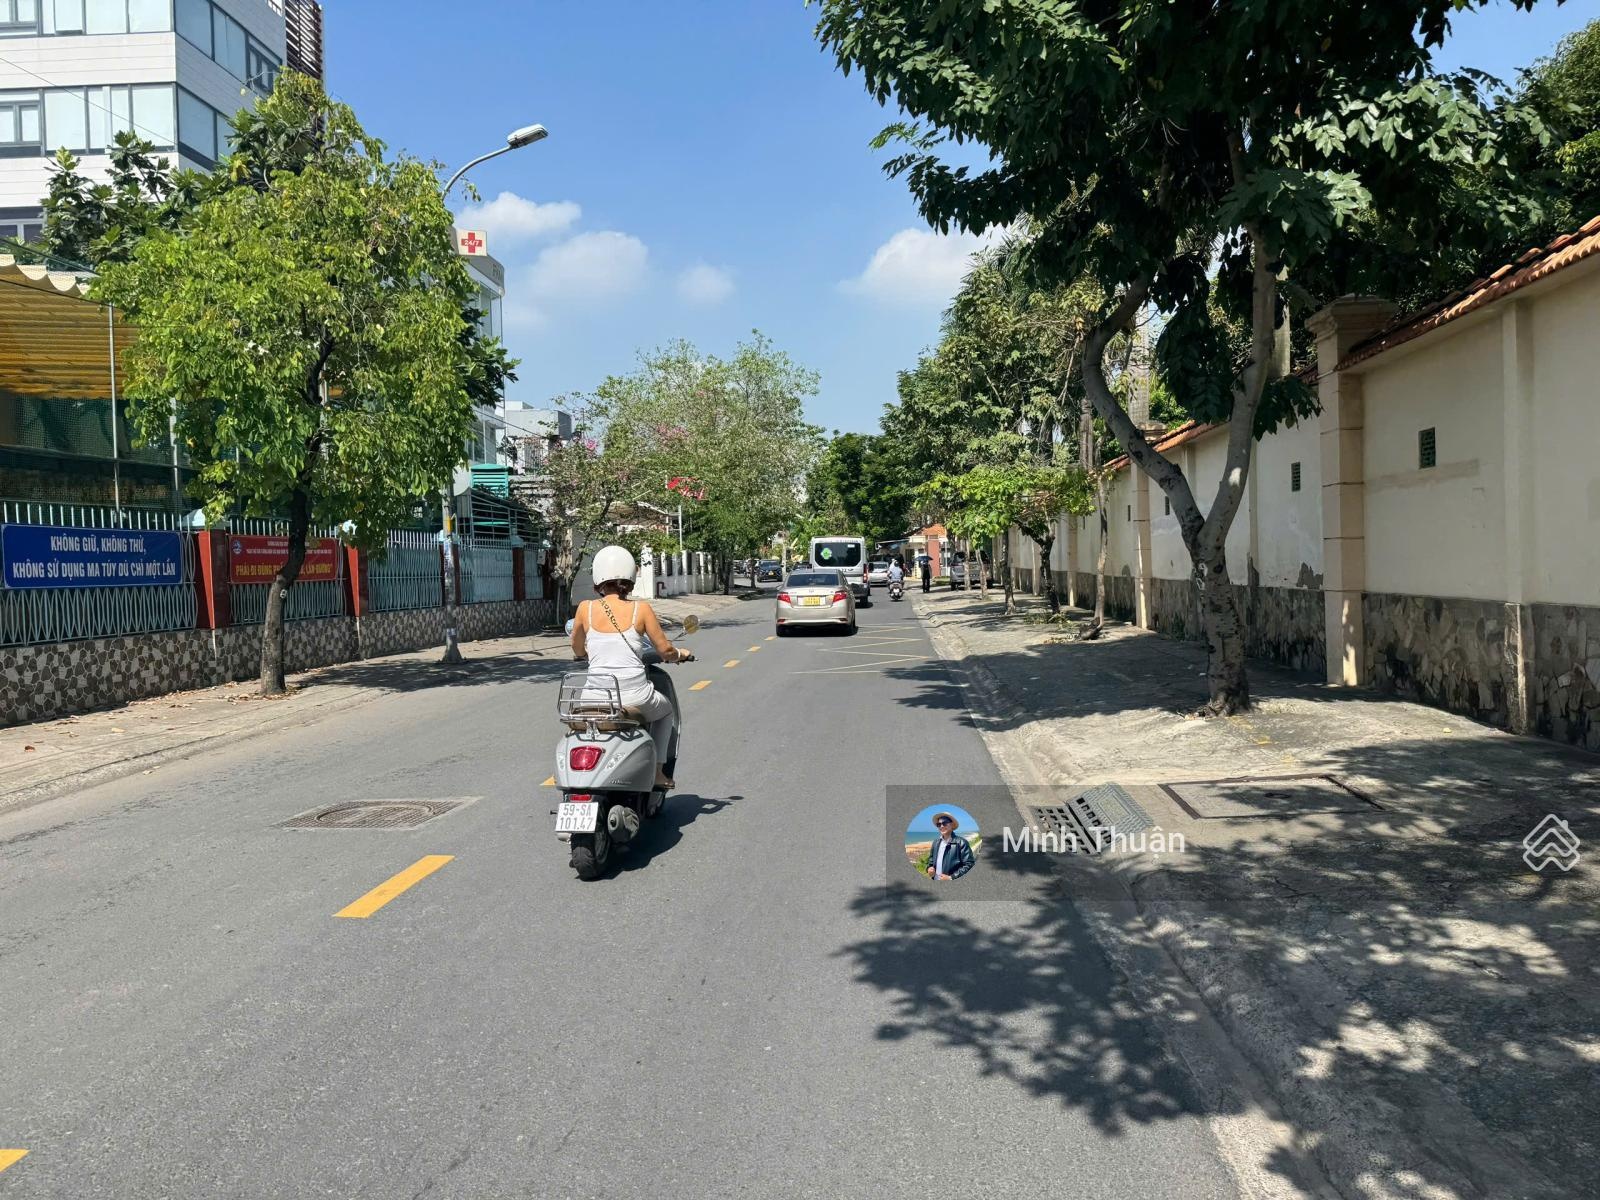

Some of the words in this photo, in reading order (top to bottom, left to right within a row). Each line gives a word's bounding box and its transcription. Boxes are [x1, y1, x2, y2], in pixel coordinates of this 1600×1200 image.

[464, 239, 480, 247] 24/7
[50, 533, 81, 552] KHÔNG
[82, 534, 100, 555] GIỮ,
[101, 534, 128, 553] KHÔNG
[129, 534, 147, 555] THỬ,
[12, 558, 45, 578] KHÔNG
[47, 557, 60, 578] SỬ
[61, 562, 85, 581] DỤNG
[87, 562, 100, 578] MA
[101, 559, 116, 577] TÚY
[130, 558, 144, 577] CHỈ
[145, 559, 161, 580] MỘT
[559, 816, 595, 830] 101.47
